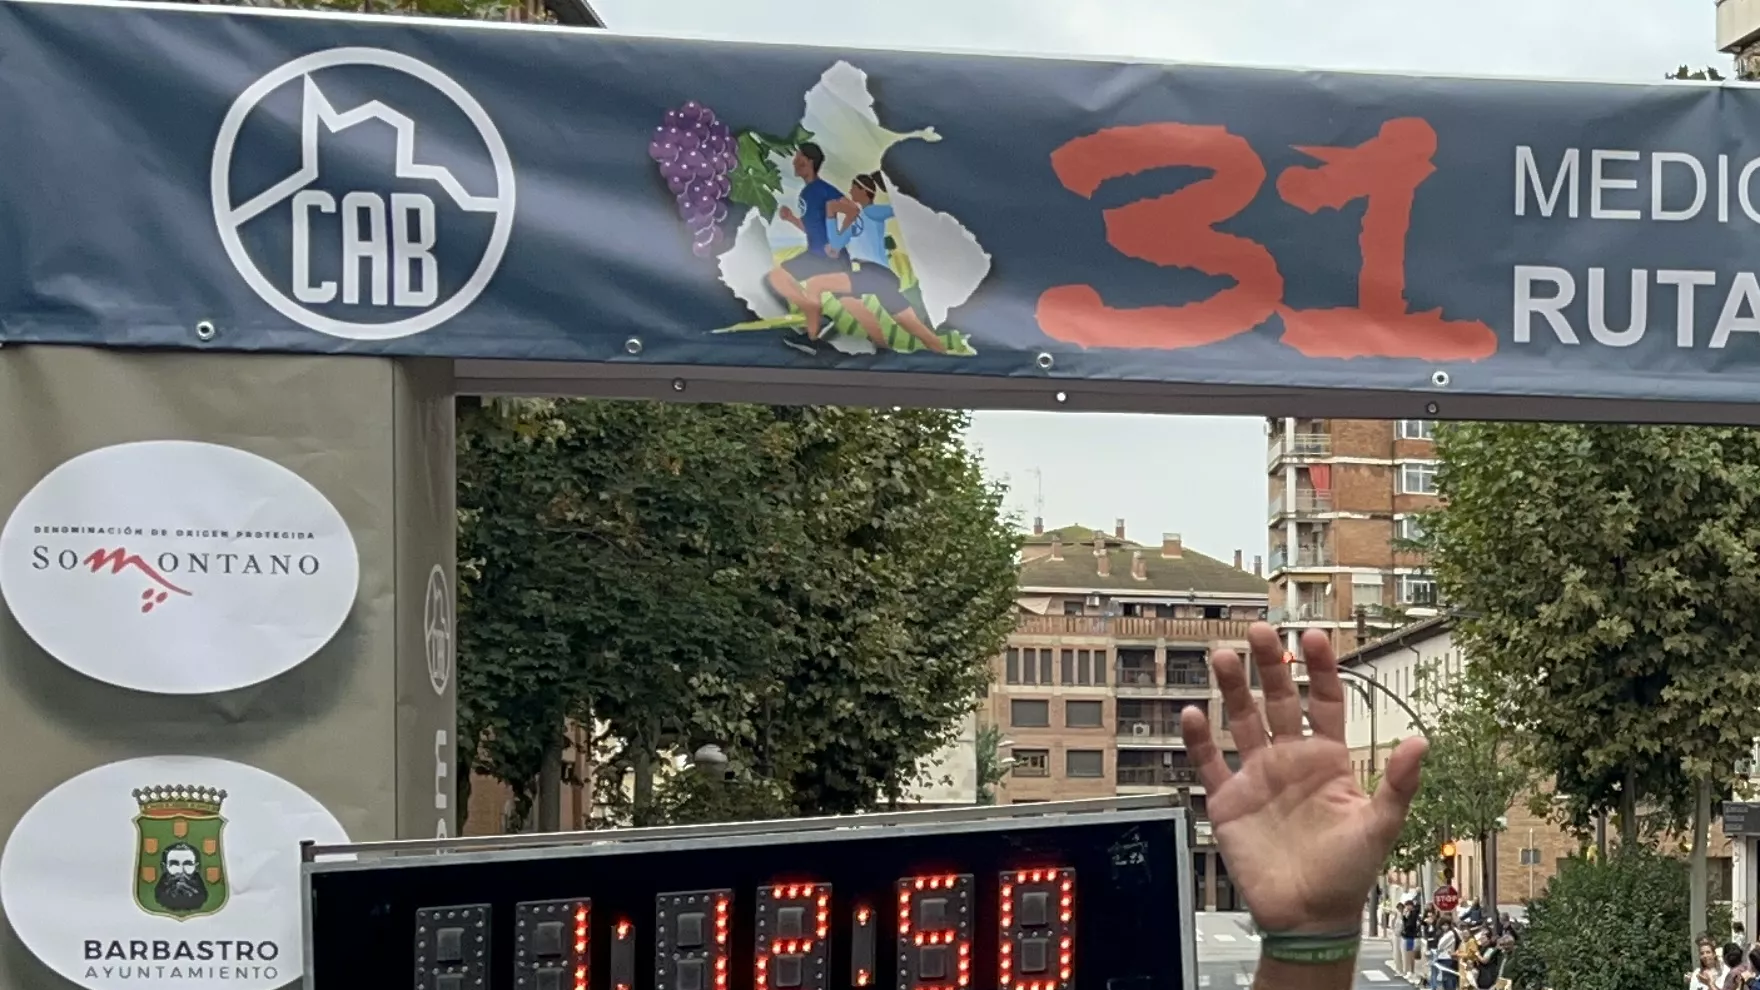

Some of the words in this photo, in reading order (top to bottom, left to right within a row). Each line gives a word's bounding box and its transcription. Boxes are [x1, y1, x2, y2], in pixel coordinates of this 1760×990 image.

[1035, 115, 1498, 361] 31
[291, 189, 440, 308] CAB
[151, 528, 168, 537] DE
[176, 529, 230, 539] ORIGEN
[236, 531, 316, 540] PROTEGIDA
[1435, 894, 1458, 905] STOP
[83, 939, 280, 962] BARBASTRO
[84, 965, 279, 980] AYUNTAMIENTO
